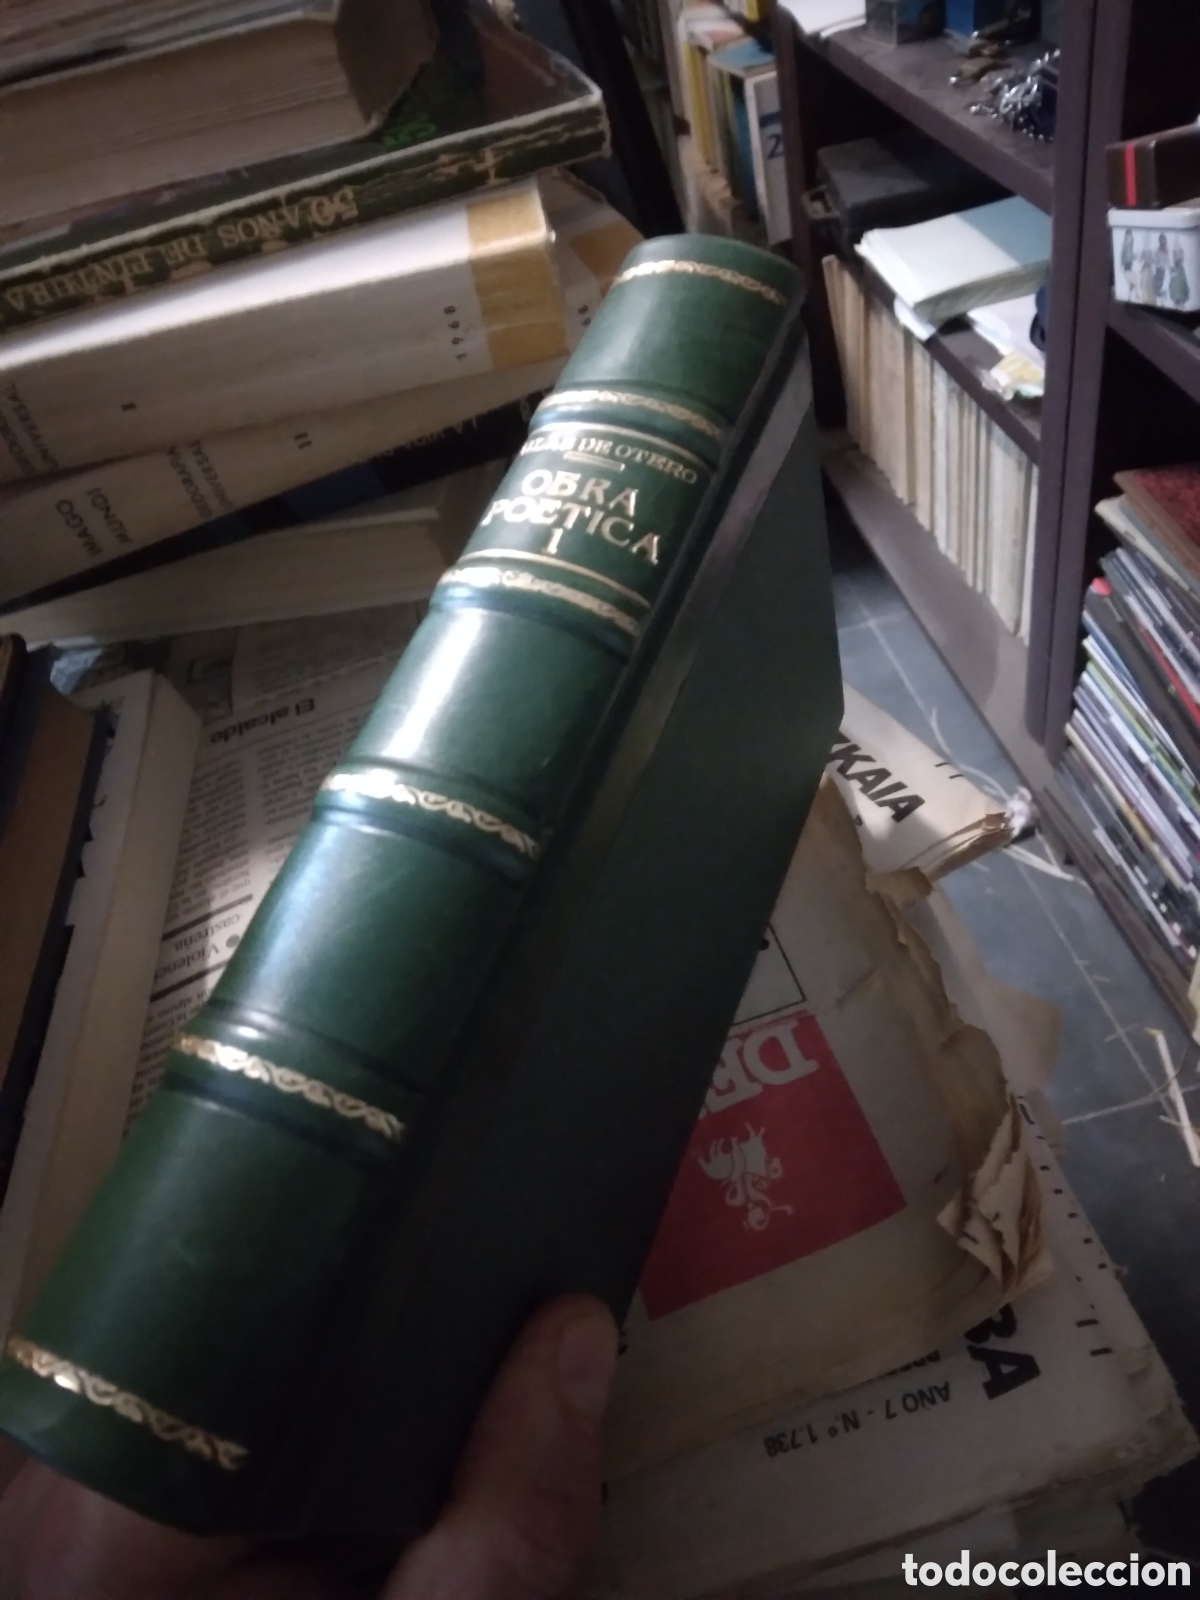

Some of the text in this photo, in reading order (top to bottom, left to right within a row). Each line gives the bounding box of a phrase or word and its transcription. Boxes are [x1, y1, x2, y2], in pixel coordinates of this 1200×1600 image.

[614, 443, 698, 485] OTERO
[86, 487, 133, 544] MUNDI
[520, 468, 640, 517] OBRA
[55, 499, 104, 557] IMAGO
[884, 1398, 898, 1420] 7
